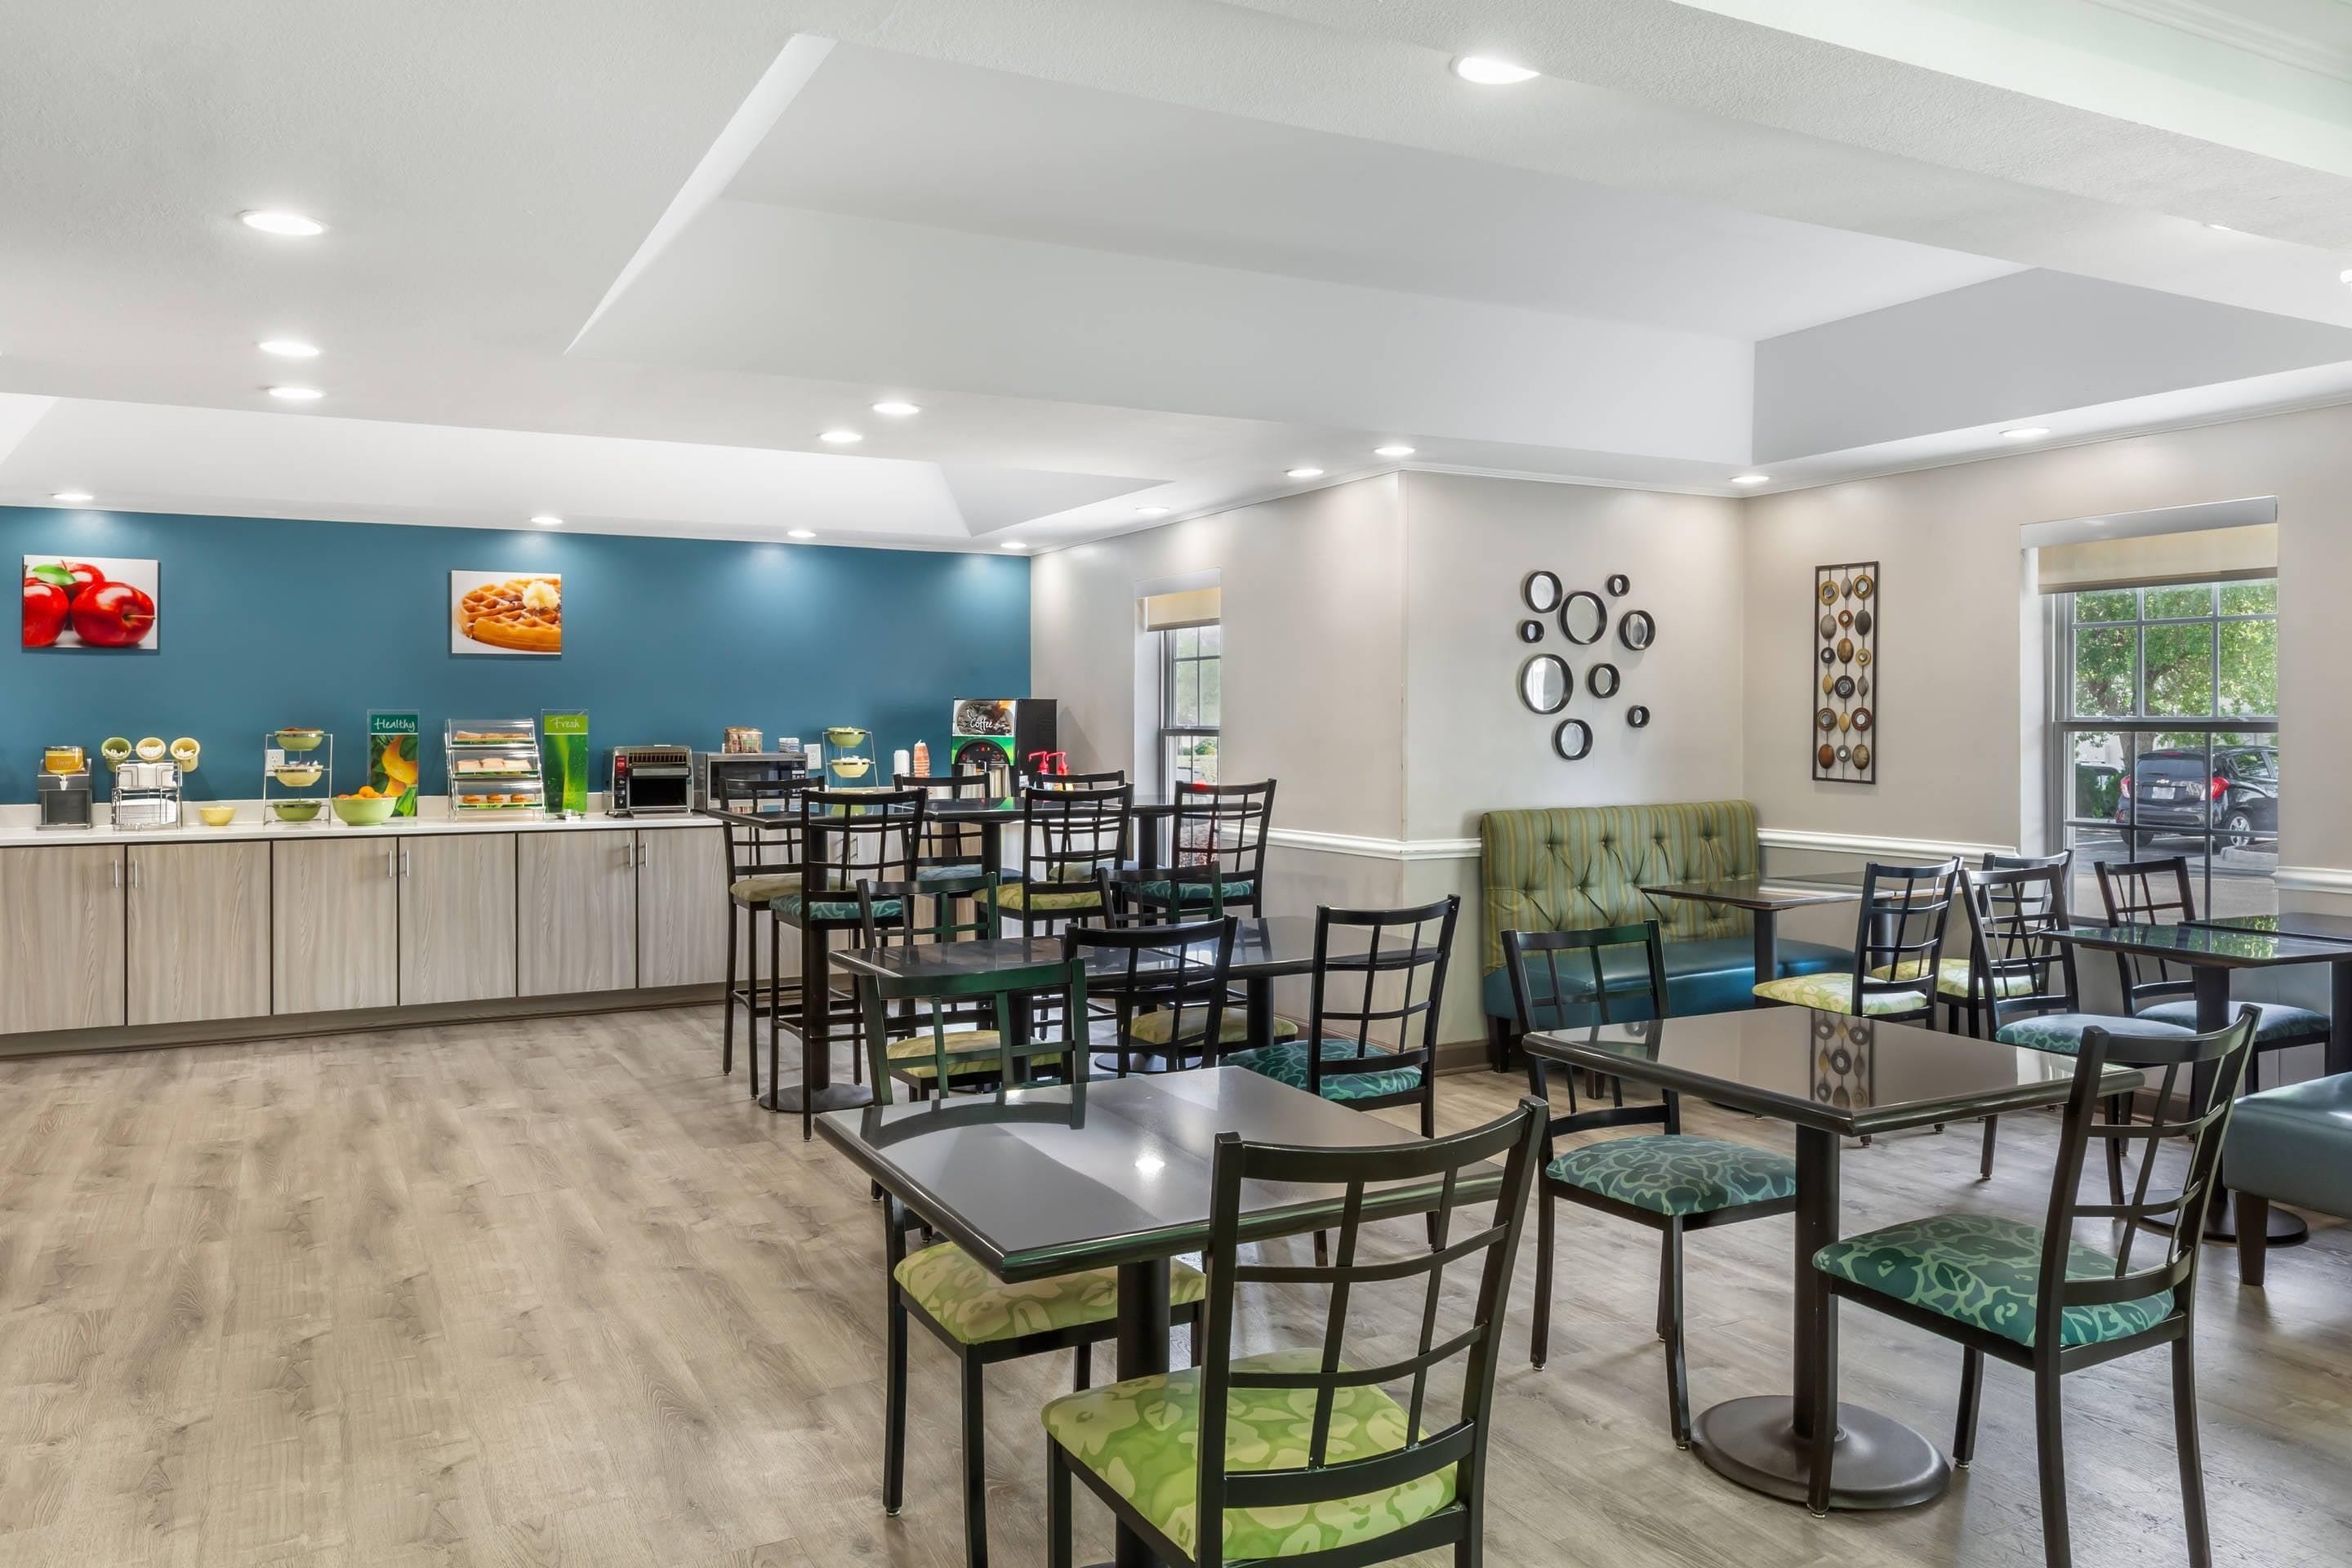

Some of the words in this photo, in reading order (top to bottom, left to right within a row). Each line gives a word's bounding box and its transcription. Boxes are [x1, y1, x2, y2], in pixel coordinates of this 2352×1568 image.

[373, 718, 415, 733] Healthy
[550, 717, 581, 729] Fresh
[969, 718, 993, 731] Coffee
